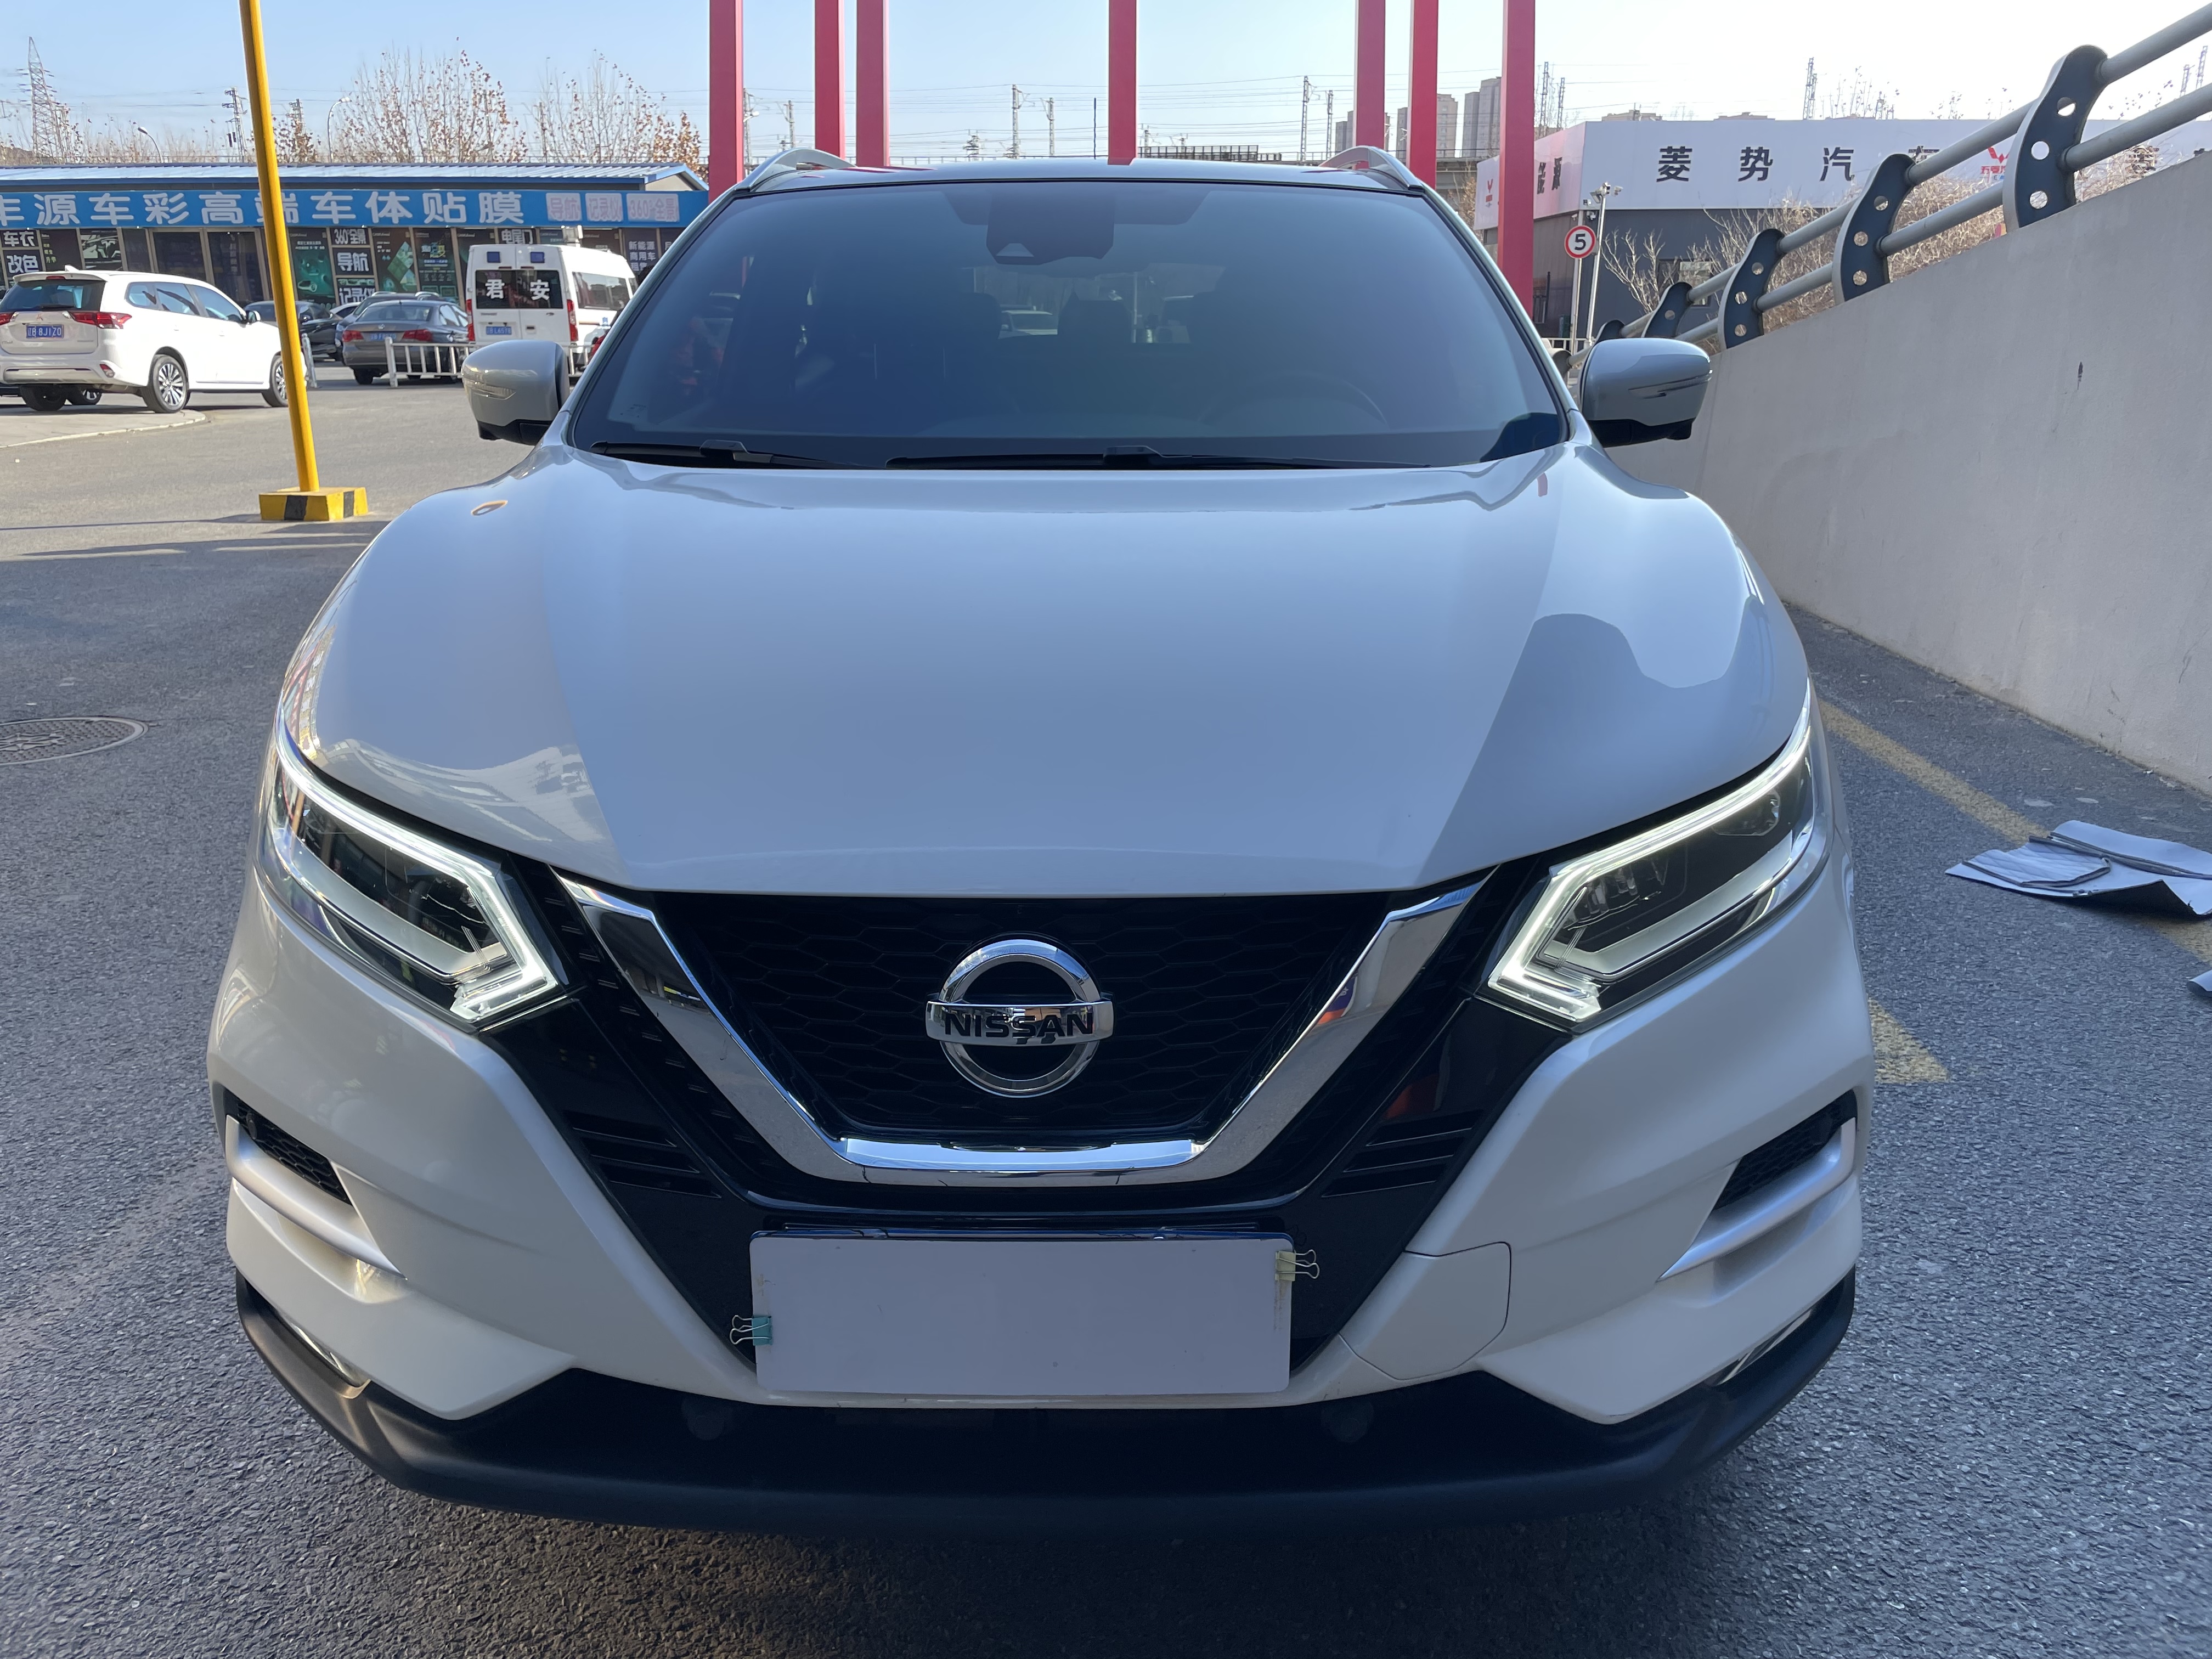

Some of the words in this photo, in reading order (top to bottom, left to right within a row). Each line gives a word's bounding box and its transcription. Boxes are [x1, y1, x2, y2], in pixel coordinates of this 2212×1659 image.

[550, 197, 579, 219] 导航
[588, 196, 622, 219] 记录仪
[3, 230, 36, 247] 车衣
[1575, 233, 1586, 250] 5
[7, 255, 39, 274] 改色
[337, 252, 369, 272] 导航
[945, 1012, 1093, 1038] NISSAN
